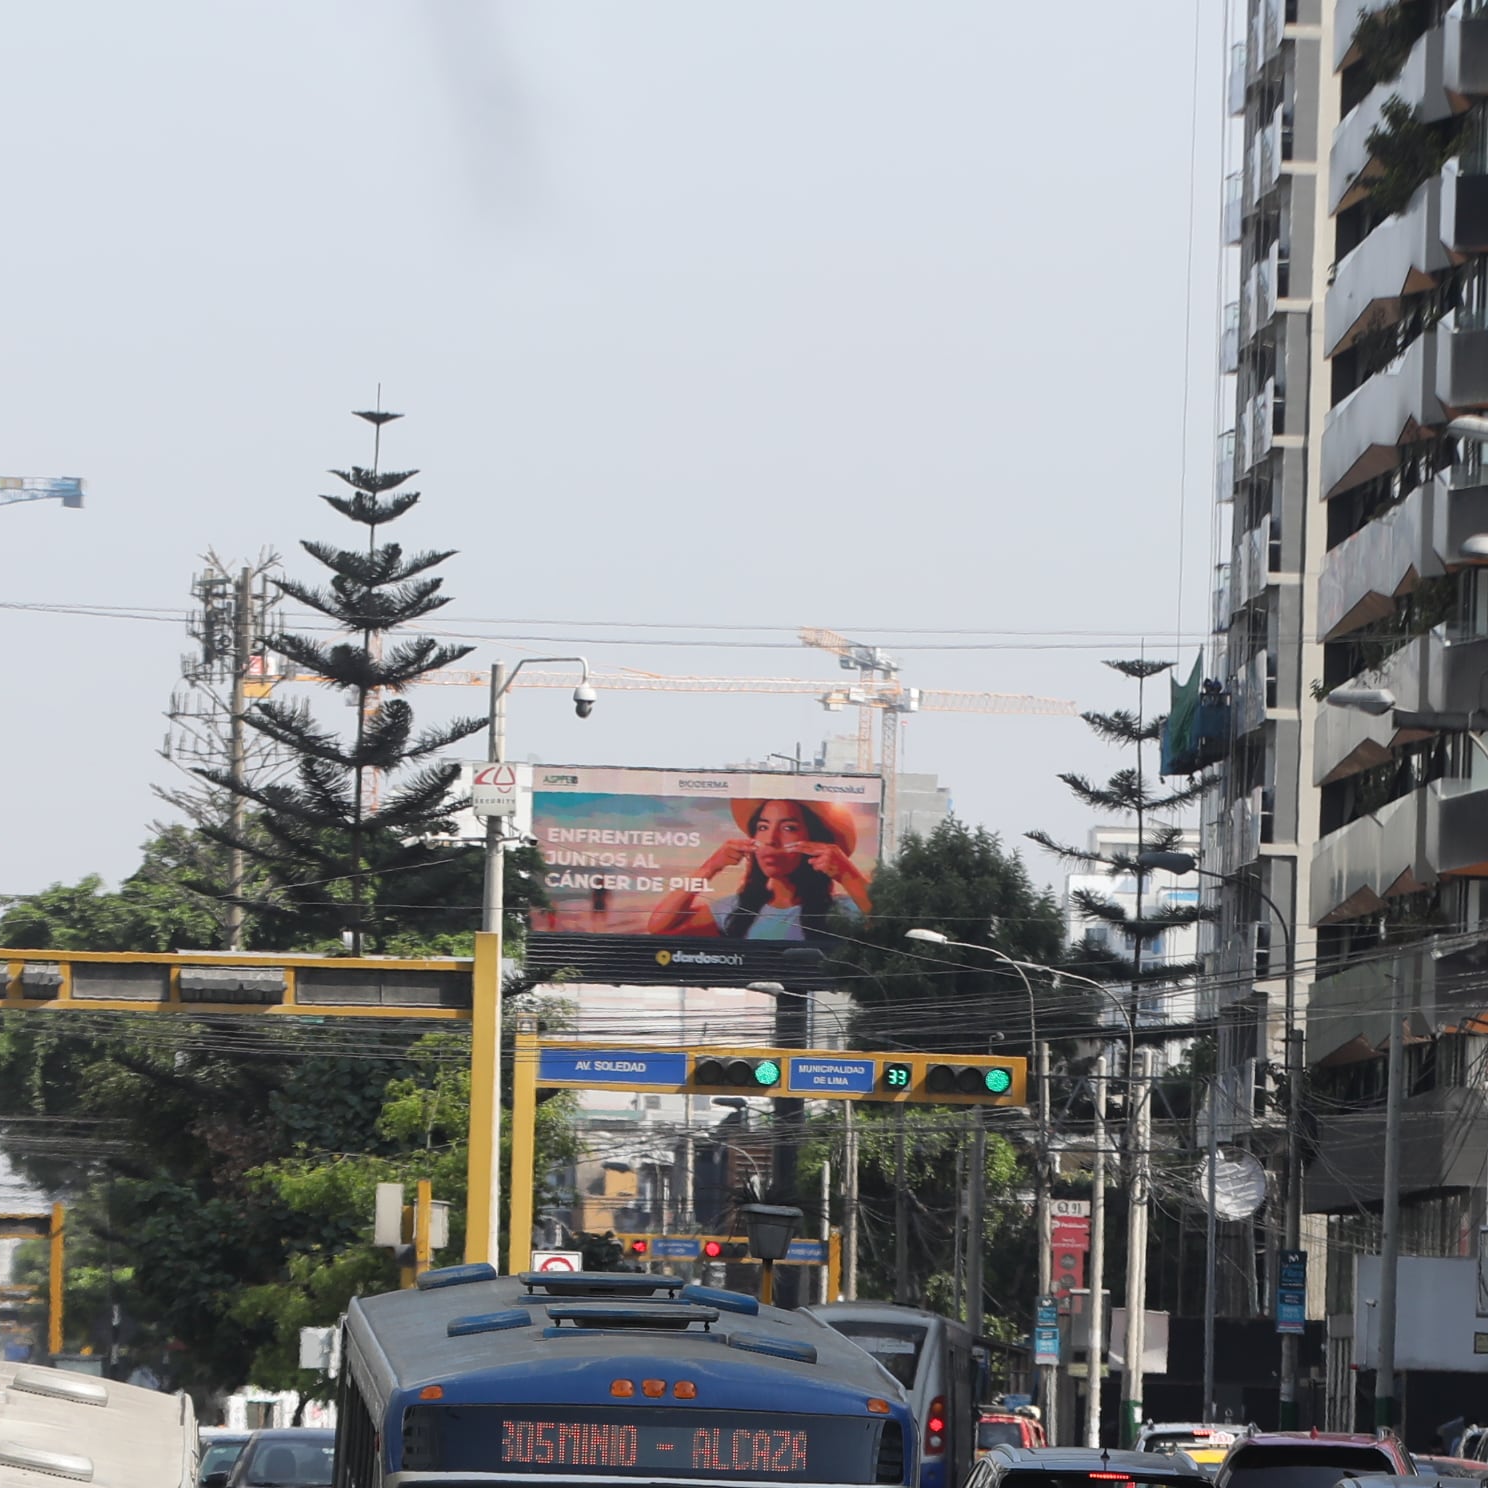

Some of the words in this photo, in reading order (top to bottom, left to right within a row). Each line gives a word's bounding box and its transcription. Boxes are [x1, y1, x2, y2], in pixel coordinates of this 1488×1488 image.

[548, 828, 700, 847] ENFRENTEMOS
[545, 850, 626, 867] JUNTOS
[632, 853, 660, 869] AL
[545, 869, 630, 890] CÁNCER
[637, 874, 664, 892] DE
[669, 876, 714, 893] PIEL
[594, 1061, 646, 1072] SOLEDAD
[798, 1065, 865, 1074] MUNICIPALIDAD
[813, 1076, 826, 1084] DE
[828, 1077, 848, 1085] LIMA
[888, 1069, 907, 1086] 33
